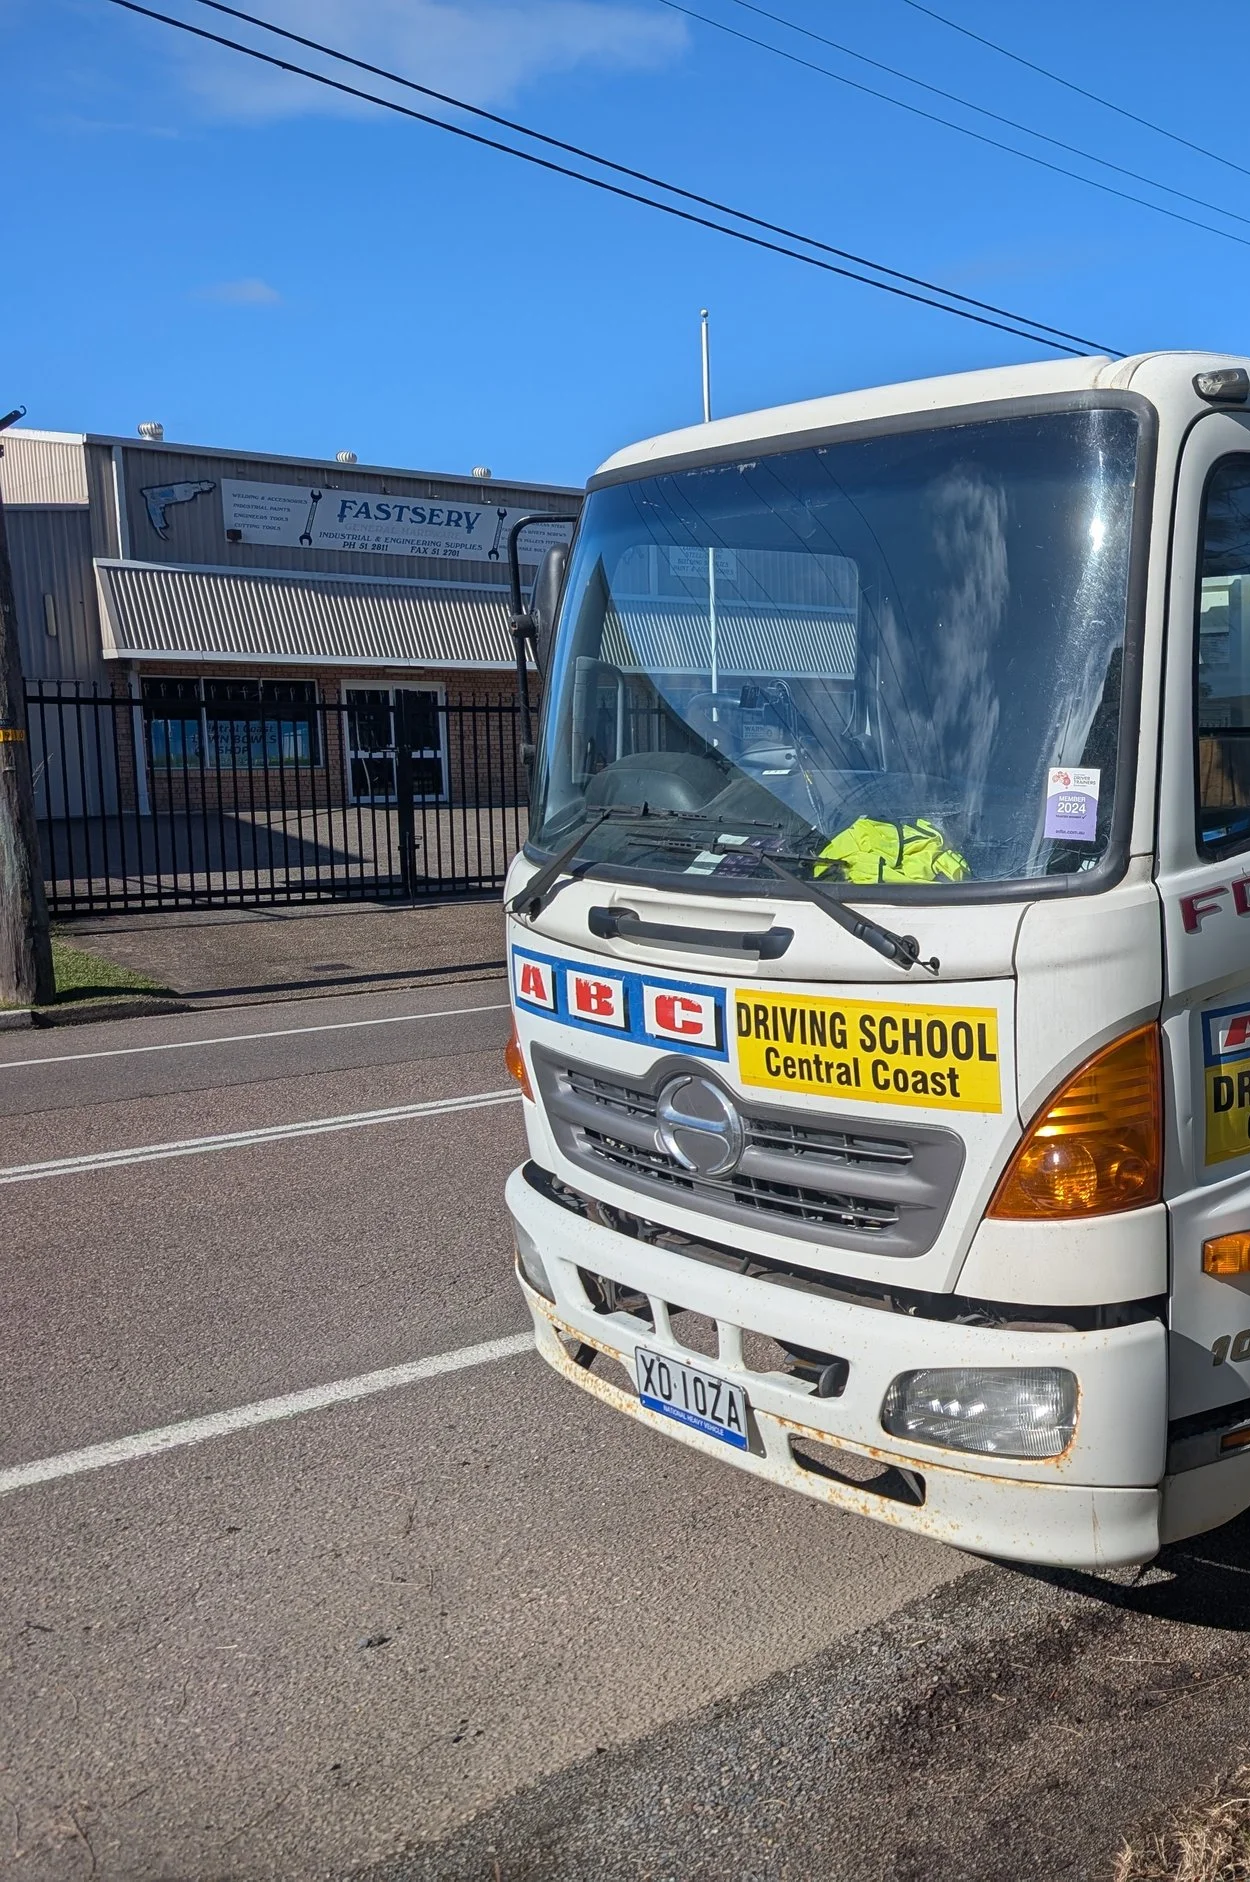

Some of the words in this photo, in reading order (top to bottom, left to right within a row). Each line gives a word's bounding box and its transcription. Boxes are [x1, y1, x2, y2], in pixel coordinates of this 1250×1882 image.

[267, 496, 308, 504] ACCESSORIES
[337, 500, 482, 534] FASTSERV
[319, 532, 372, 541] INDUSTRIAL
[384, 537, 442, 547] ENGINEERING
[445, 542, 483, 550] SUPPLIES
[342, 541, 356, 549] PH
[371, 543, 388, 551] 2811
[410, 546, 428, 554] FAX
[442, 549, 460, 557] 2701
[1057, 803, 1087, 814] 2024
[737, 1002, 848, 1050] DRIVING
[859, 1015, 997, 1062] SCHOOL
[765, 1046, 861, 1088] Central
[871, 1058, 961, 1098] Coast
